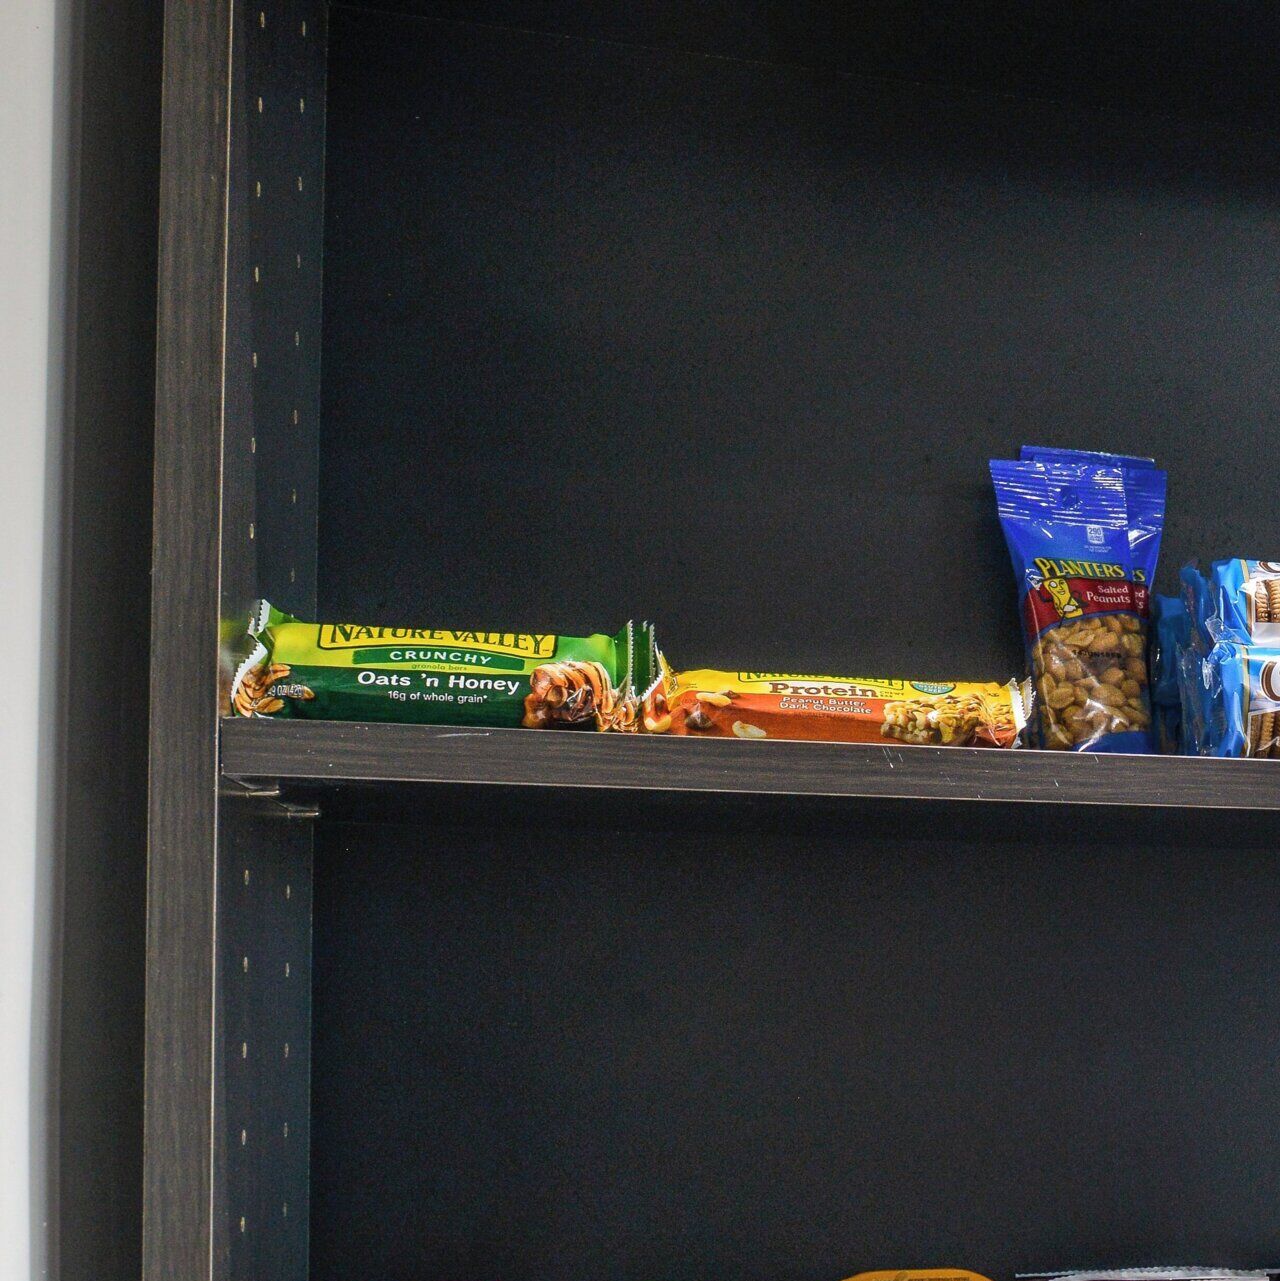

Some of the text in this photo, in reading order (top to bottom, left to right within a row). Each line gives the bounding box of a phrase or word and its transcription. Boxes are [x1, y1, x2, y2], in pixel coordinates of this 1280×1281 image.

[1035, 557, 1125, 580] PLANTERS
[1098, 585, 1129, 595] Salted
[1087, 591, 1131, 604] Peanuts
[389, 651, 493, 665] CRUNCHY
[357, 671, 411, 688] Oats
[448, 676, 520, 696] Honey
[769, 683, 878, 699] Protein
[779, 702, 872, 714] Dark Chocolate
[783, 696, 866, 707] Peanut Butter
